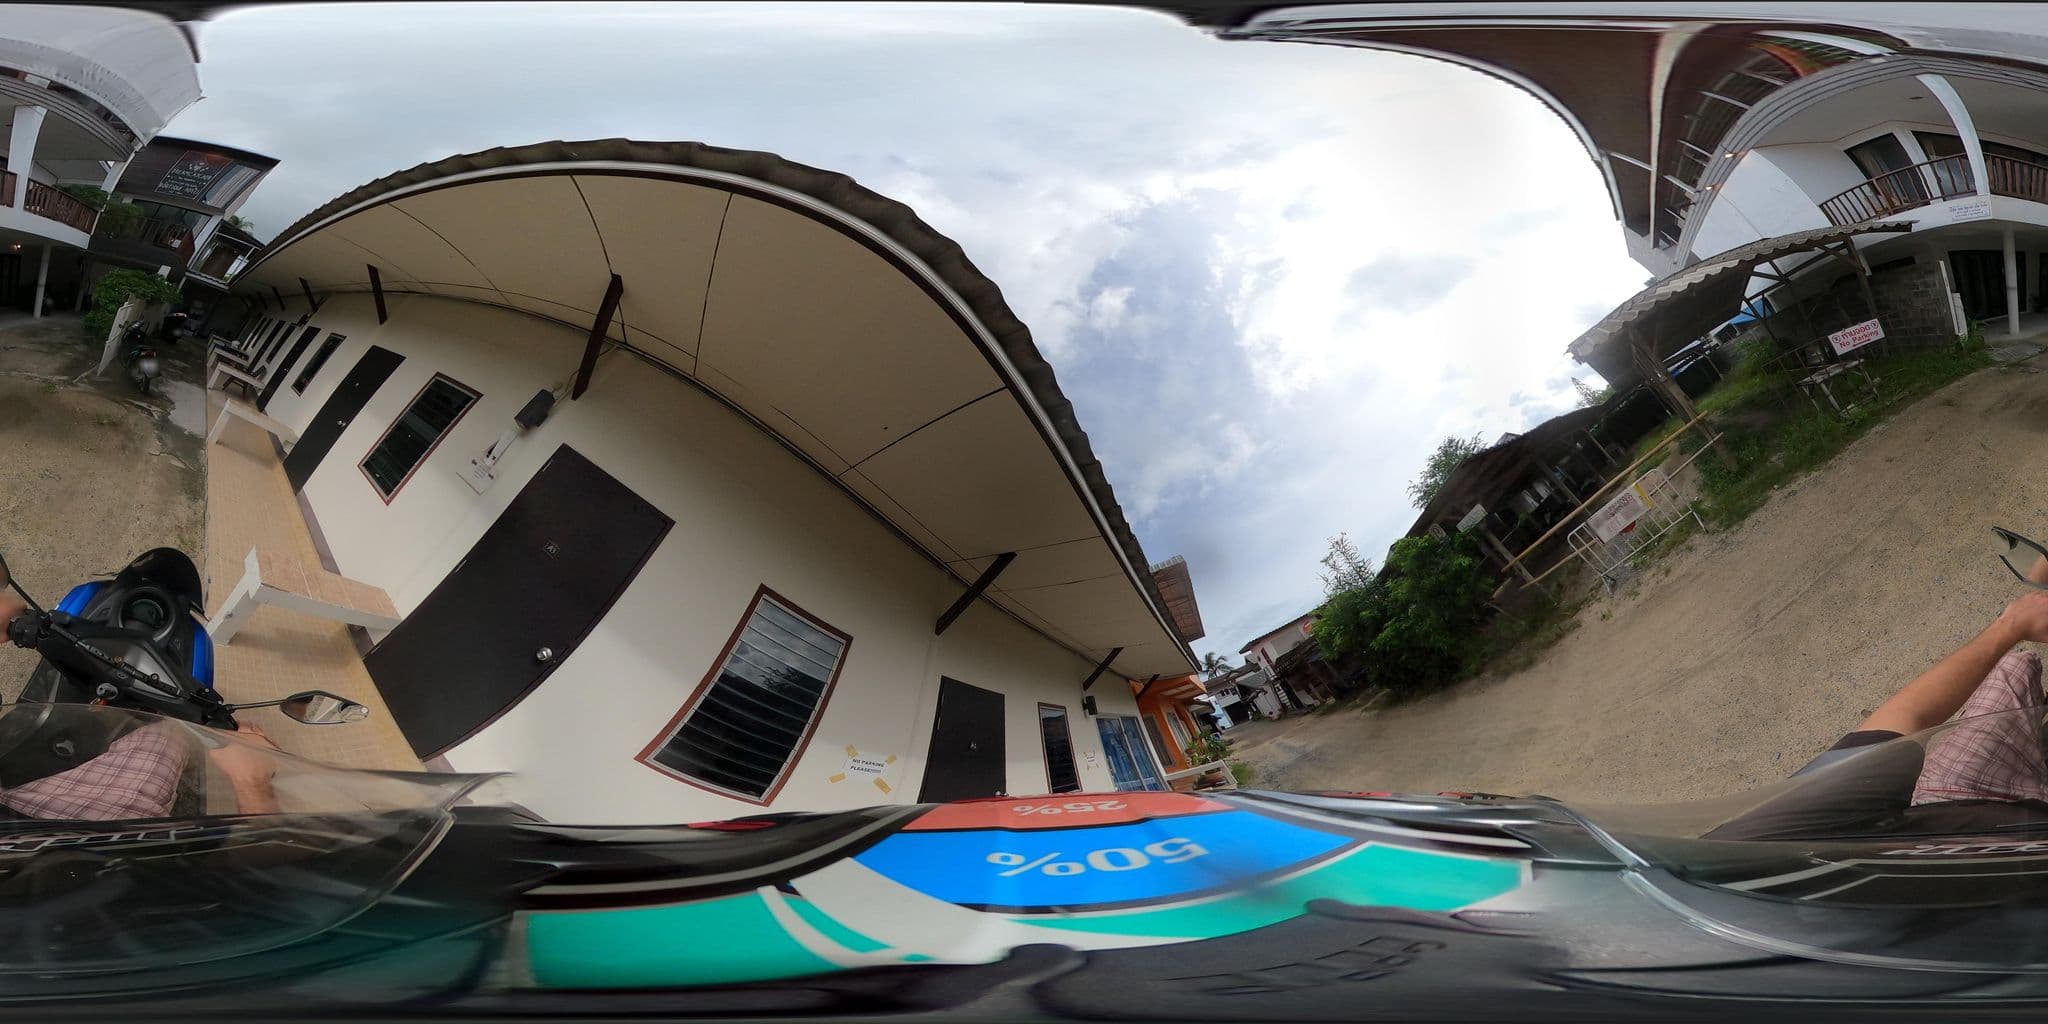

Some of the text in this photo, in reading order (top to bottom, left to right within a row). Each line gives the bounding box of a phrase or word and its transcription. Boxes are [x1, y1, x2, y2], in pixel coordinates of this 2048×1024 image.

[1839, 330, 1879, 349] No Parking
[861, 760, 885, 768] PARKING
[1012, 800, 1128, 816] 25%
[986, 837, 1210, 877] 50%
